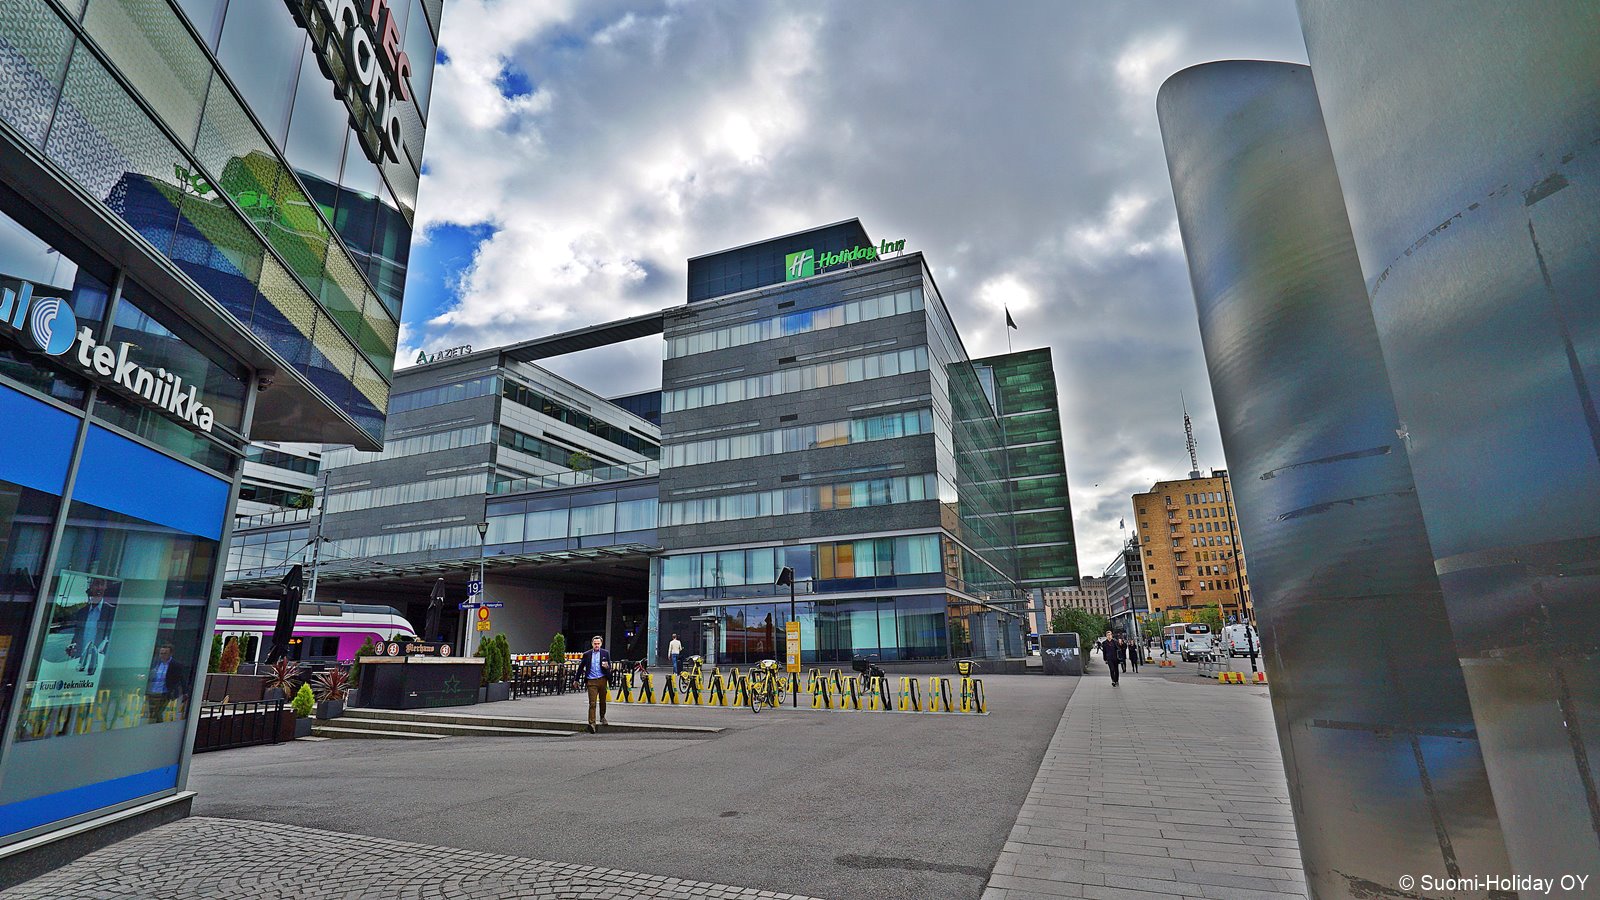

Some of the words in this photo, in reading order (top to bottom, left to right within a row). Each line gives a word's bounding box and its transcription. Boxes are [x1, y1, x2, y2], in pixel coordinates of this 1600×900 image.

[819, 245, 877, 268] Holiday
[880, 238, 905, 255] Inn
[468, 582, 479, 593] 19
